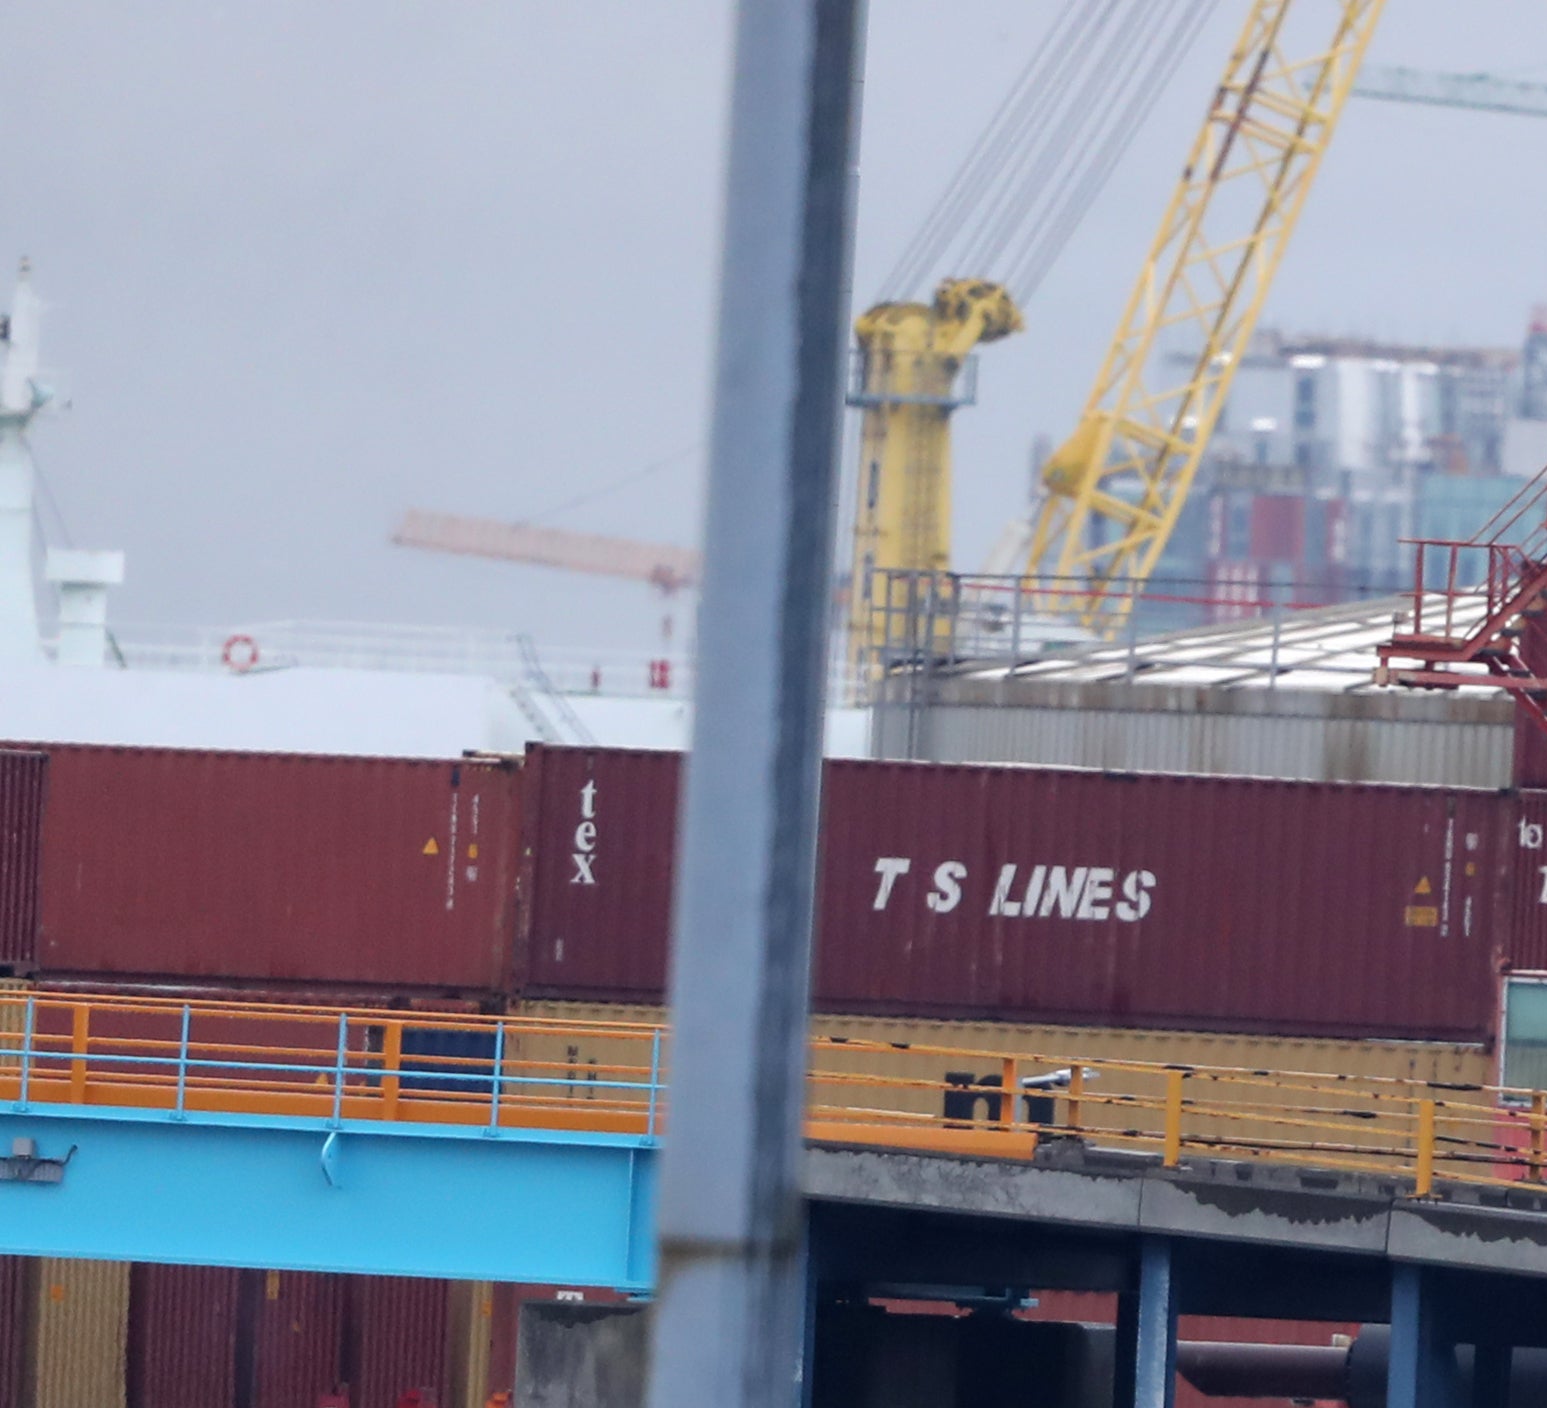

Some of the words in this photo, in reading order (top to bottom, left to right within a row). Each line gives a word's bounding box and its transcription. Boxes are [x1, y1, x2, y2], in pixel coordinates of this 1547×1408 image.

[570, 780, 597, 884] tex
[873, 857, 911, 911] T
[926, 860, 968, 913] S
[988, 863, 1157, 922] LINES
